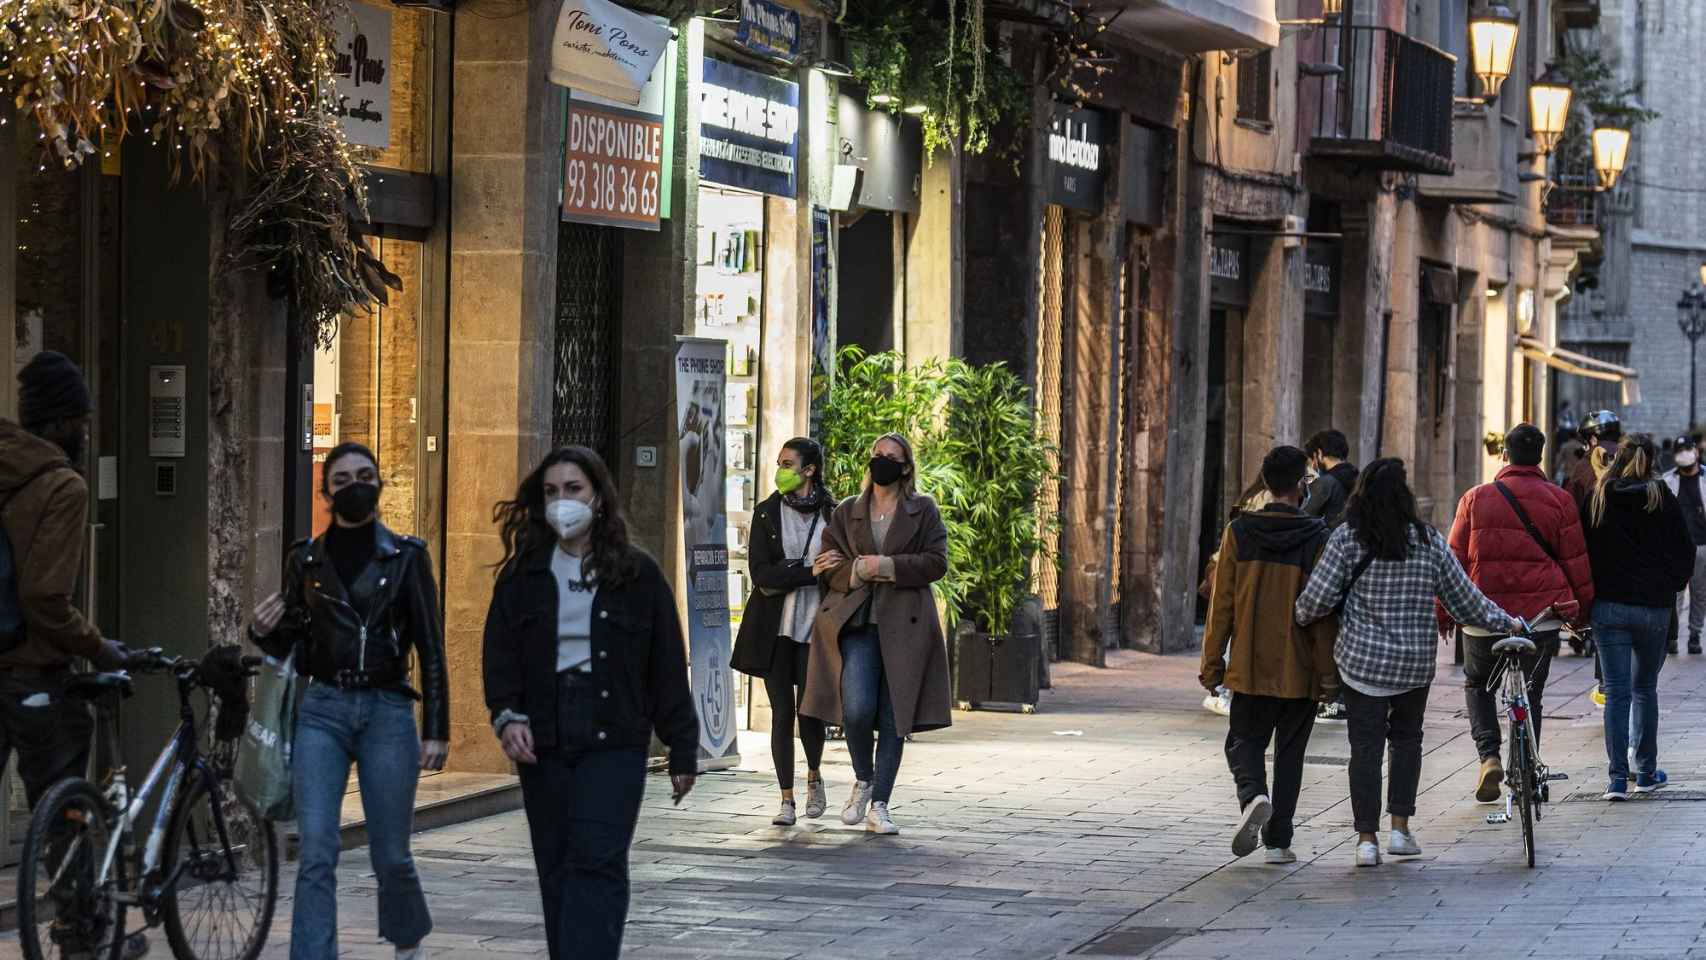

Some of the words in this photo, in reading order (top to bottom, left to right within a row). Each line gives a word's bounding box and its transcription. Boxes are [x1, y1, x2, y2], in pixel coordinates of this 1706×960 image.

[568, 9, 606, 35] Toni
[608, 27, 650, 57] Pons
[756, 3, 780, 32] Phone
[570, 112, 661, 164] DISPONIBLE
[568, 159, 586, 207] 93
[591, 162, 615, 210] 318
[620, 166, 637, 213] 36
[641, 170, 658, 216] 63
[678, 357, 689, 373] THE
[690, 358, 709, 374] PHONE
[710, 358, 725, 374] SHOP
[707, 669, 721, 713] 45
